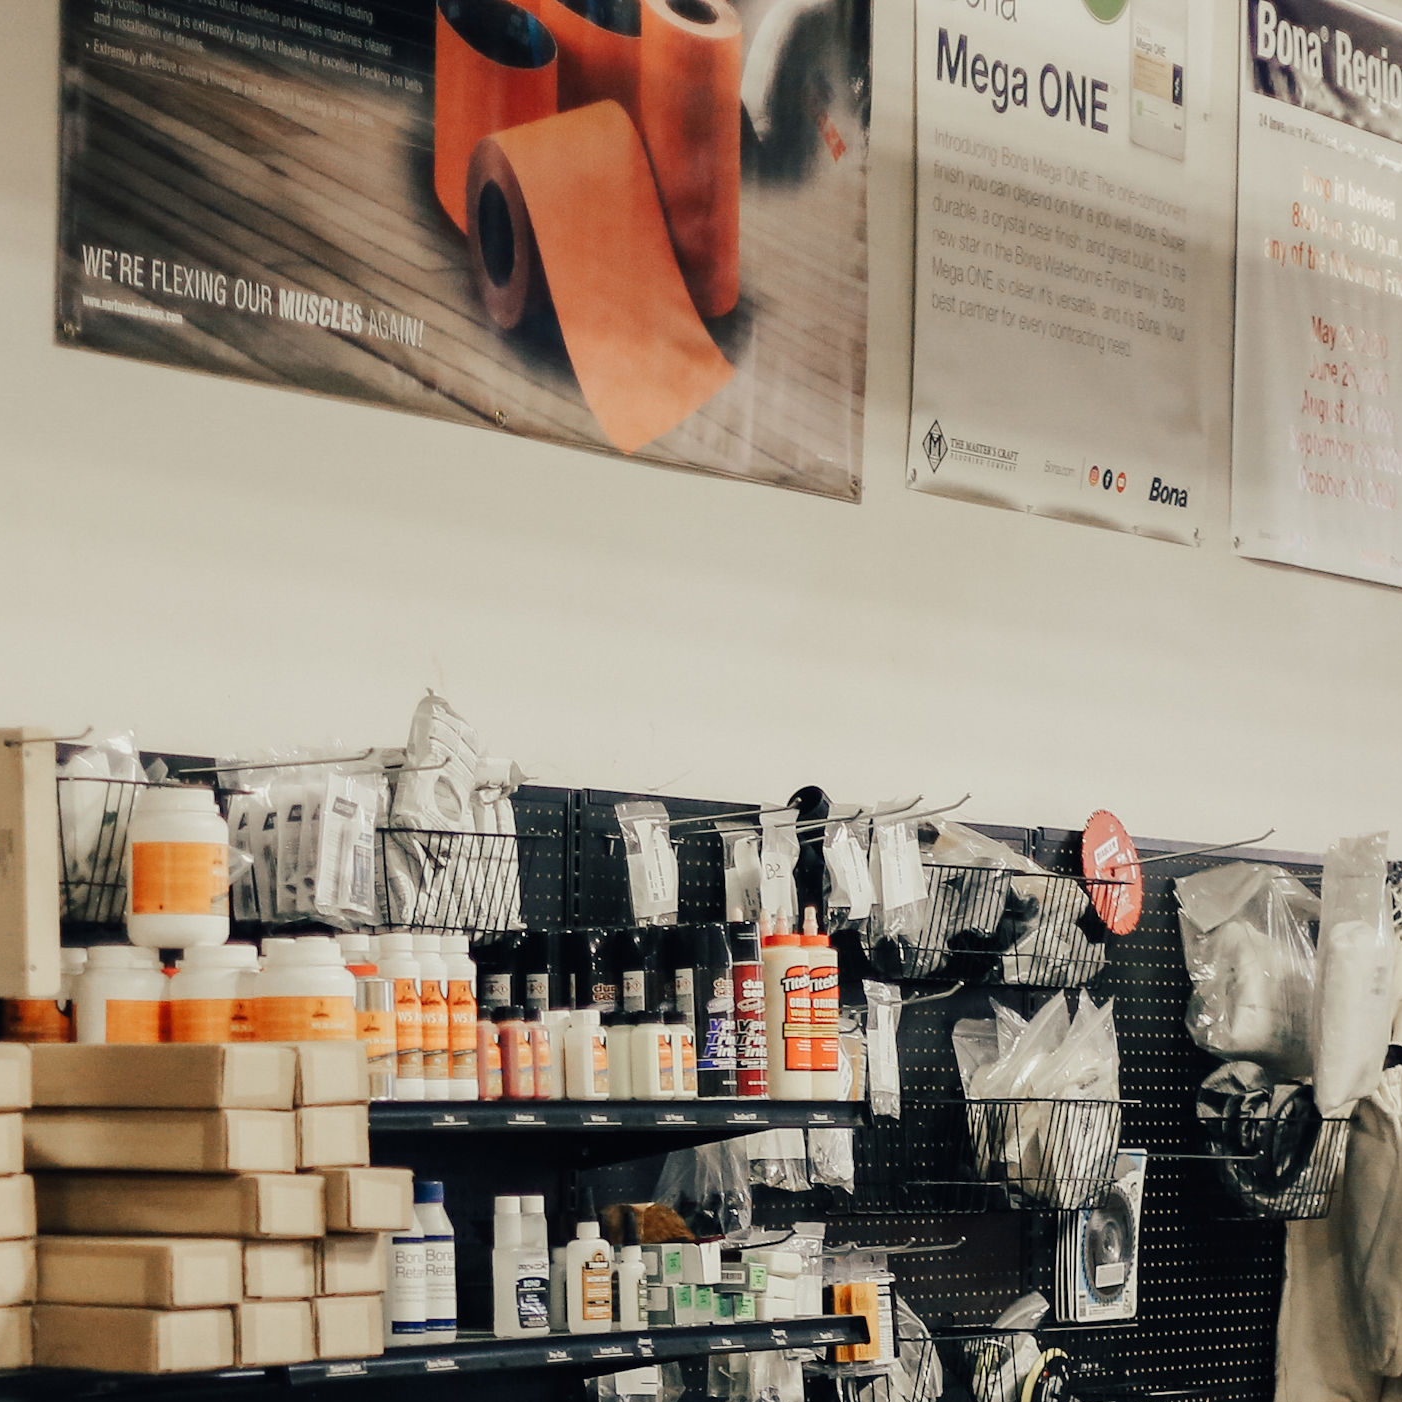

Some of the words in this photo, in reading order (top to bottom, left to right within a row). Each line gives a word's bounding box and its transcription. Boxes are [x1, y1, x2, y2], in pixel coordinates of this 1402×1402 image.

[182, 16, 191, 29] is
[192, 19, 235, 43] extremely
[93, 39, 136, 65] Extremely
[936, 26, 1029, 113] Mega
[1039, 63, 1109, 134] ONE
[935, 128, 997, 167] Introducing
[1002, 146, 1028, 171] Bona
[1033, 157, 1061, 184] Mega
[934, 160, 964, 184] finish
[967, 172, 988, 192] you
[990, 180, 1010, 196] can
[991, 211, 1026, 234] crystal
[933, 228, 956, 248] new
[959, 234, 980, 253] star
[996, 243, 1013, 263] the
[1016, 246, 1042, 271] Bona
[1291, 241, 1304, 266] of
[932, 256, 964, 286] Mega
[967, 264, 993, 290] ONE
[82, 245, 144, 288] WE'RE
[152, 259, 227, 306] FLEXING
[235, 278, 273, 316] OUR
[279, 288, 363, 334] MUSCLES
[368, 309, 424, 348] AGAIN!
[932, 292, 956, 313] best
[959, 299, 999, 323] partner
[1019, 314, 1048, 337] every
[1311, 315, 1337, 351] May
[1301, 388, 1345, 425] August
[1149, 477, 1188, 508] Bona
[425, 1248, 455, 1263] Bona
